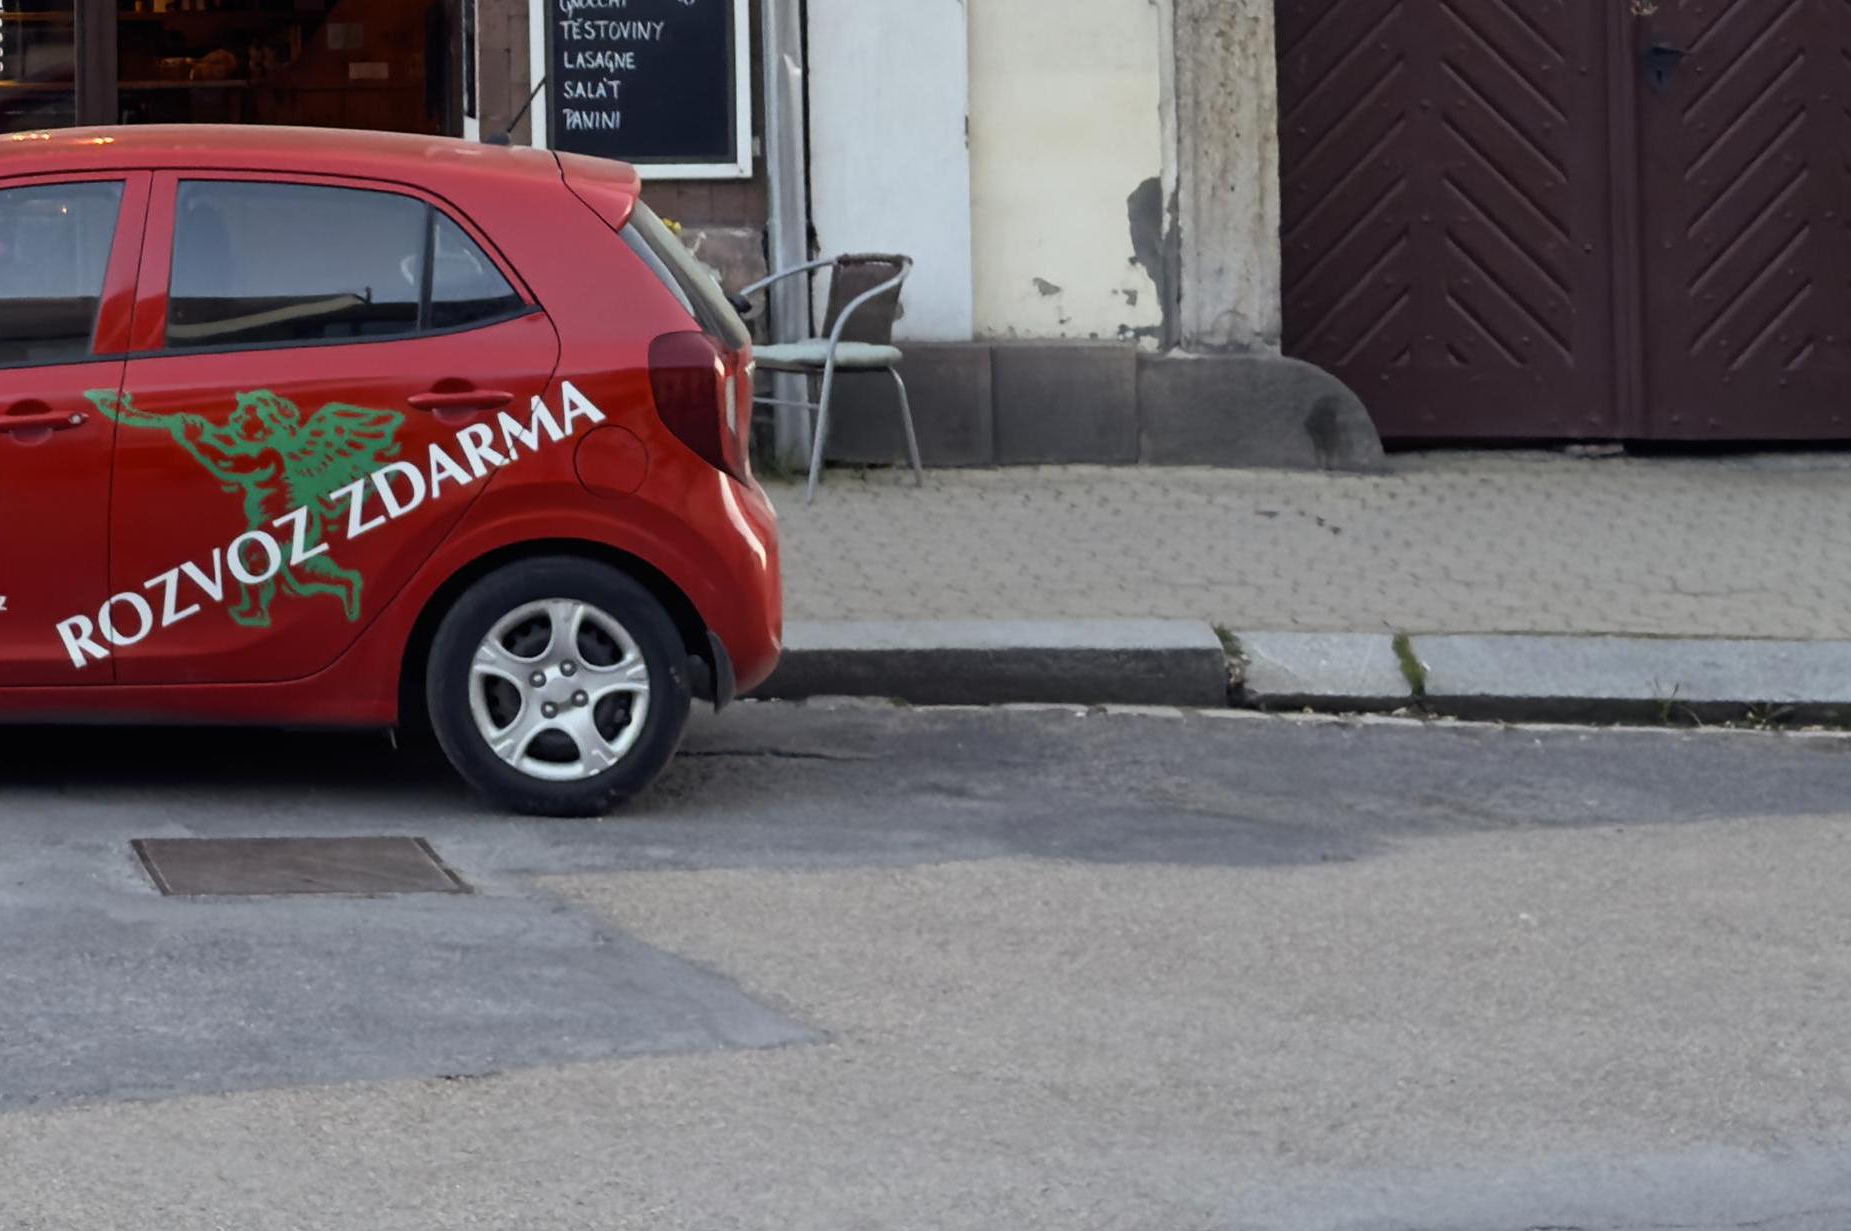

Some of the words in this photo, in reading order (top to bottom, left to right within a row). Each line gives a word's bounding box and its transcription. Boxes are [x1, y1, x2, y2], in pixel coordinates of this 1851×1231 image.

[559, 19, 665, 41] TĚSTOVINY
[563, 51, 636, 72] LASAGNE
[563, 109, 621, 131] PANINI
[55, 505, 329, 668] ROZVOZ
[329, 380, 606, 540] ZDARMA
